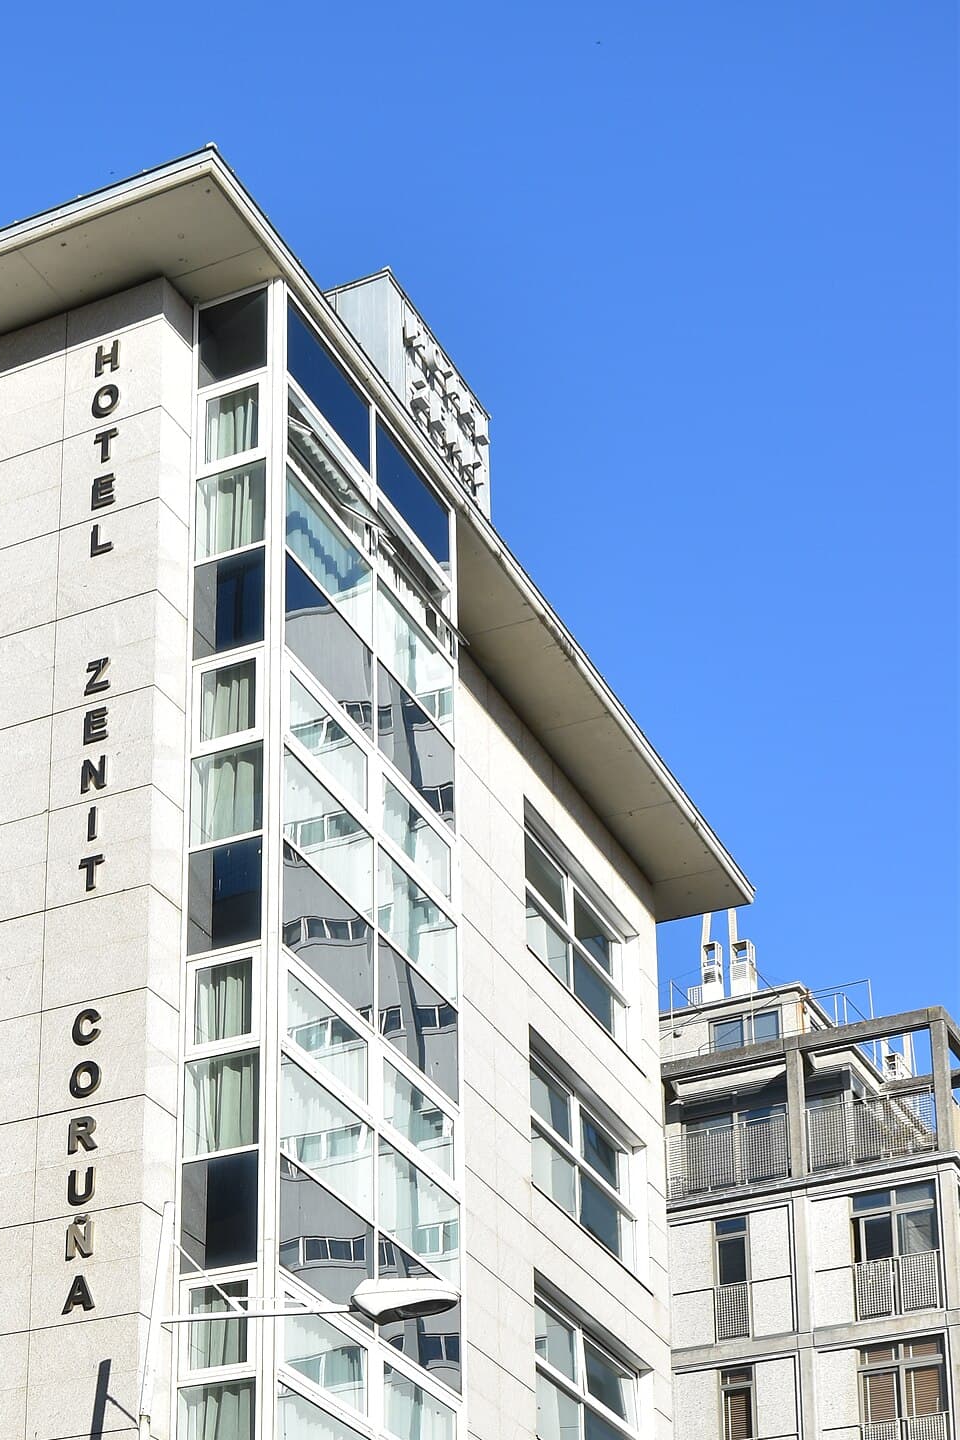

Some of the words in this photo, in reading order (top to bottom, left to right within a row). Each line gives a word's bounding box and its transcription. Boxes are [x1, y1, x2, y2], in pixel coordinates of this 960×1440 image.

[90, 339, 121, 558] HOTEL
[79, 656, 112, 892] ZENIT
[61, 1007, 103, 1316] CORUÑA
